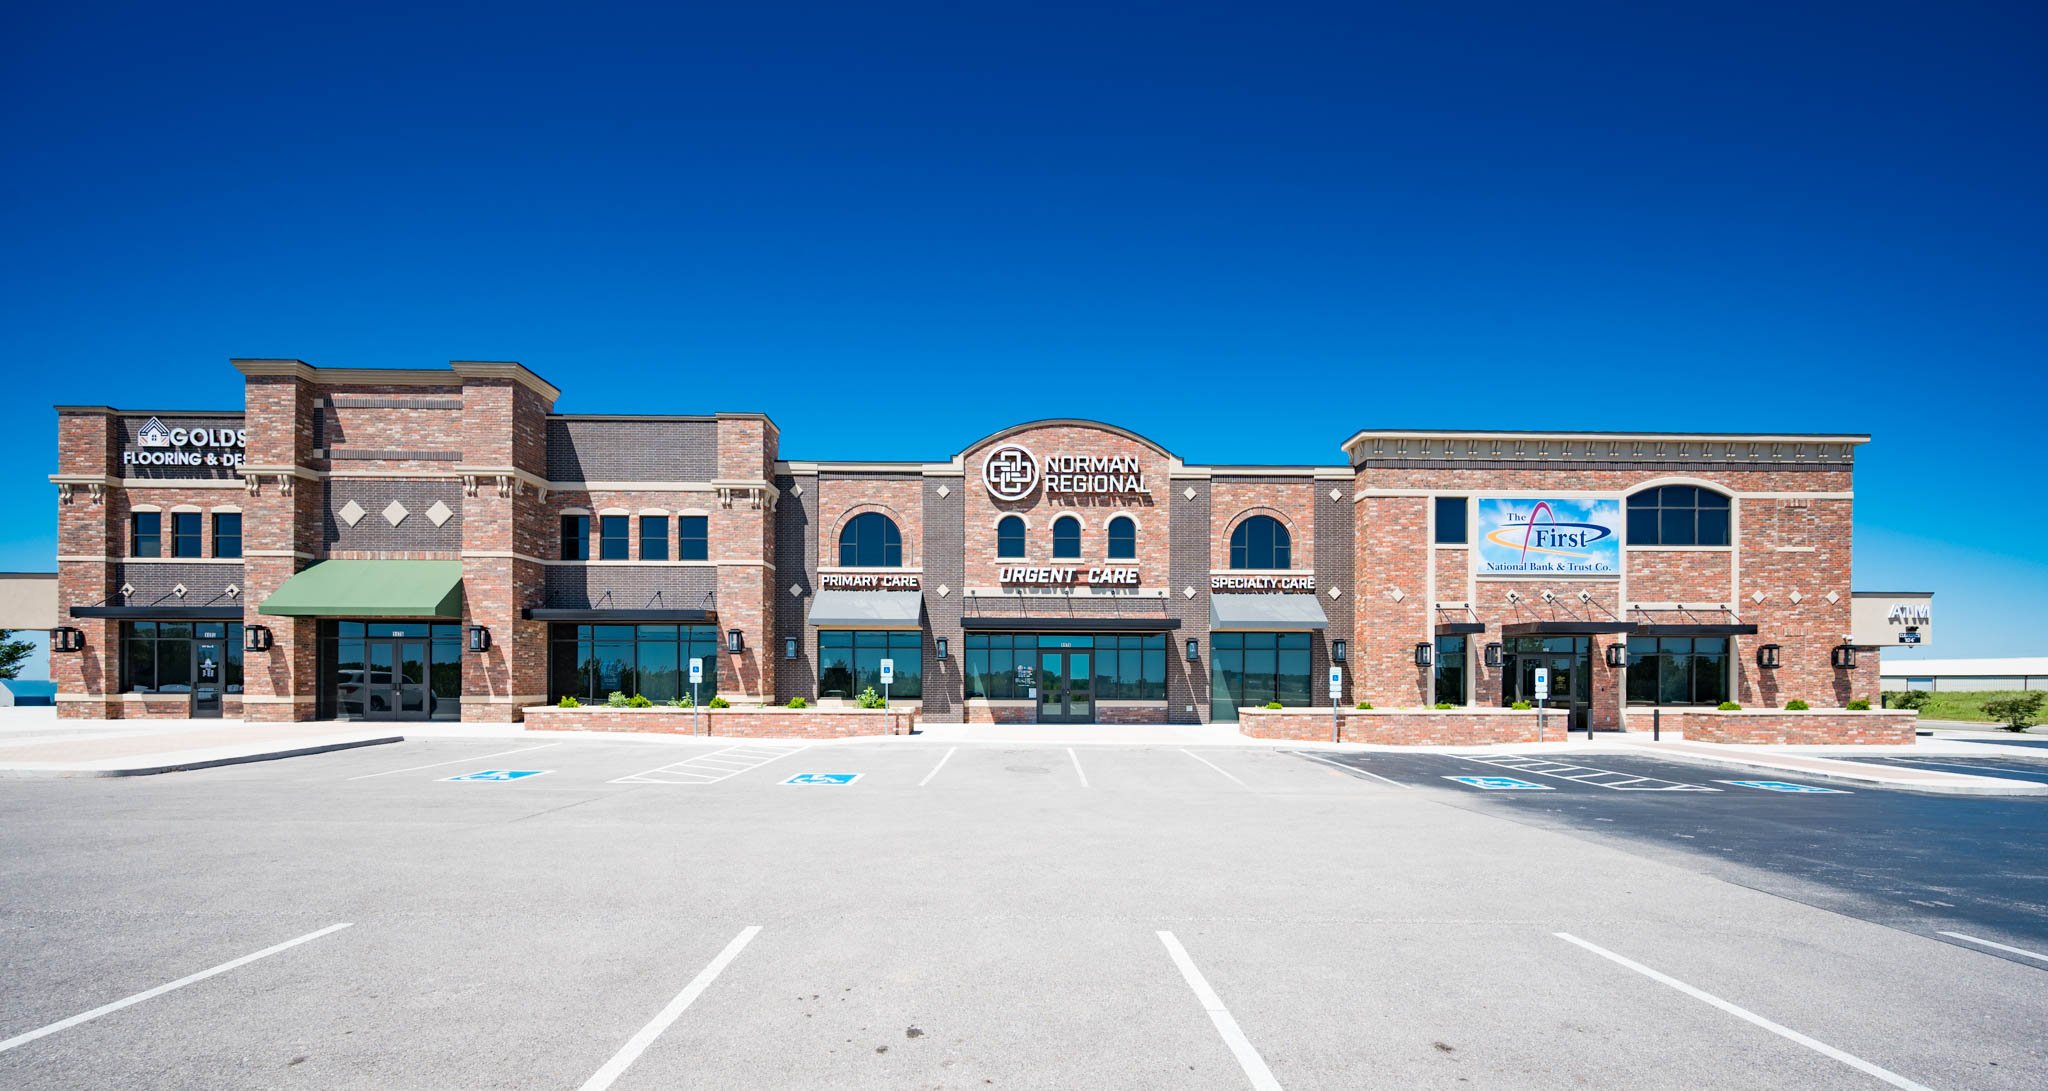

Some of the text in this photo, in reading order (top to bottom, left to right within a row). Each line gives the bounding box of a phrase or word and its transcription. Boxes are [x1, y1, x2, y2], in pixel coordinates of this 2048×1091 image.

[169, 427, 246, 448] GOLDS
[123, 451, 202, 466] FLOORING
[206, 453, 219, 466] &
[1045, 455, 1139, 473] NORMAN
[1045, 474, 1152, 493] REGIONAL
[1506, 512, 1527, 521] The
[1535, 528, 1588, 548] First
[1486, 562, 1612, 571] National Bank & Trust Co.
[821, 575, 918, 587] PRIMARY CARE
[1000, 567, 1139, 584] URGENT CARE
[1211, 576, 1316, 589] SPECIALTY CARE
[1887, 604, 1931, 618] ATM
